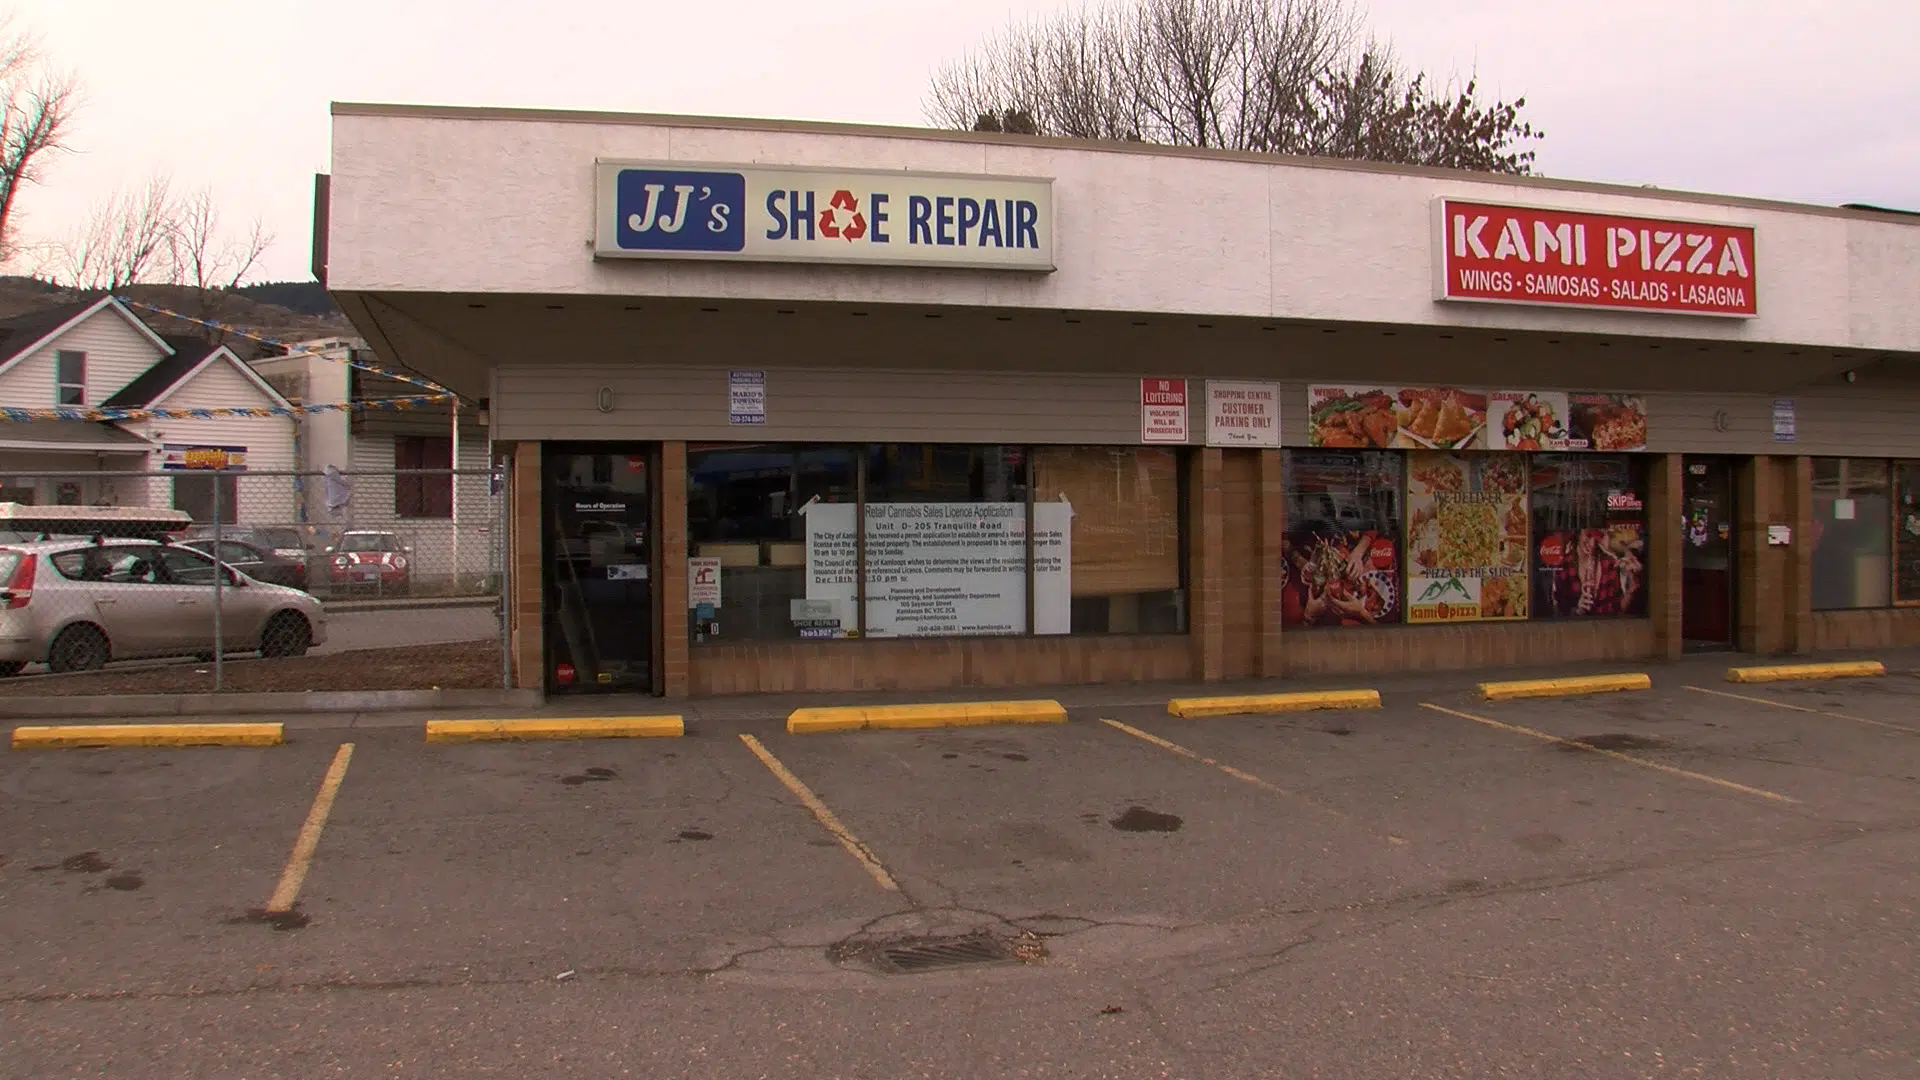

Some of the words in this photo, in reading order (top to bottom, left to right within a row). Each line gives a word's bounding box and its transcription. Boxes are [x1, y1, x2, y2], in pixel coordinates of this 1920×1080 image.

[627, 184, 731, 233] JJ's
[909, 195, 1040, 249] REPAIR
[1453, 214, 1587, 266] KAMI
[1607, 228, 1749, 278] PIZZA
[1460, 269, 1513, 292] WINGS
[1525, 273, 1600, 298] SAMOSAS
[1611, 280, 1669, 302] SALADS
[1680, 284, 1745, 307] LASAGNA
[1159, 381, 1170, 391] NO
[1145, 392, 1183, 403] LOITERING
[1213, 390, 1246, 400] SHOPPING
[1247, 391, 1272, 401] CENTRE
[1149, 409, 1179, 417] VIOLATORS
[1222, 403, 1264, 415] CUSTOMER
[1153, 418, 1167, 426] WILL
[1168, 418, 1176, 426] BE
[1215, 416, 1249, 429] PARKING
[1252, 416, 1272, 429] ONLY
[1454, 490, 1502, 504] DELIVER
[1607, 495, 1627, 507] SKIP
[865, 504, 886, 518] Retail
[888, 504, 921, 518] Cannabis
[923, 504, 944, 518] Sales
[945, 505, 972, 518] Licence
[974, 504, 1013, 521] Application
[876, 522, 895, 530] Unit
[914, 522, 931, 530] 205
[933, 521, 977, 531] Tranquille
[980, 521, 1002, 530] Road
[1425, 568, 1453, 578] PIZZA
[1455, 567, 1467, 578] BY
[1470, 567, 1487, 577] THE
[1411, 606, 1437, 618] kami
[1450, 606, 1477, 619] pizza
